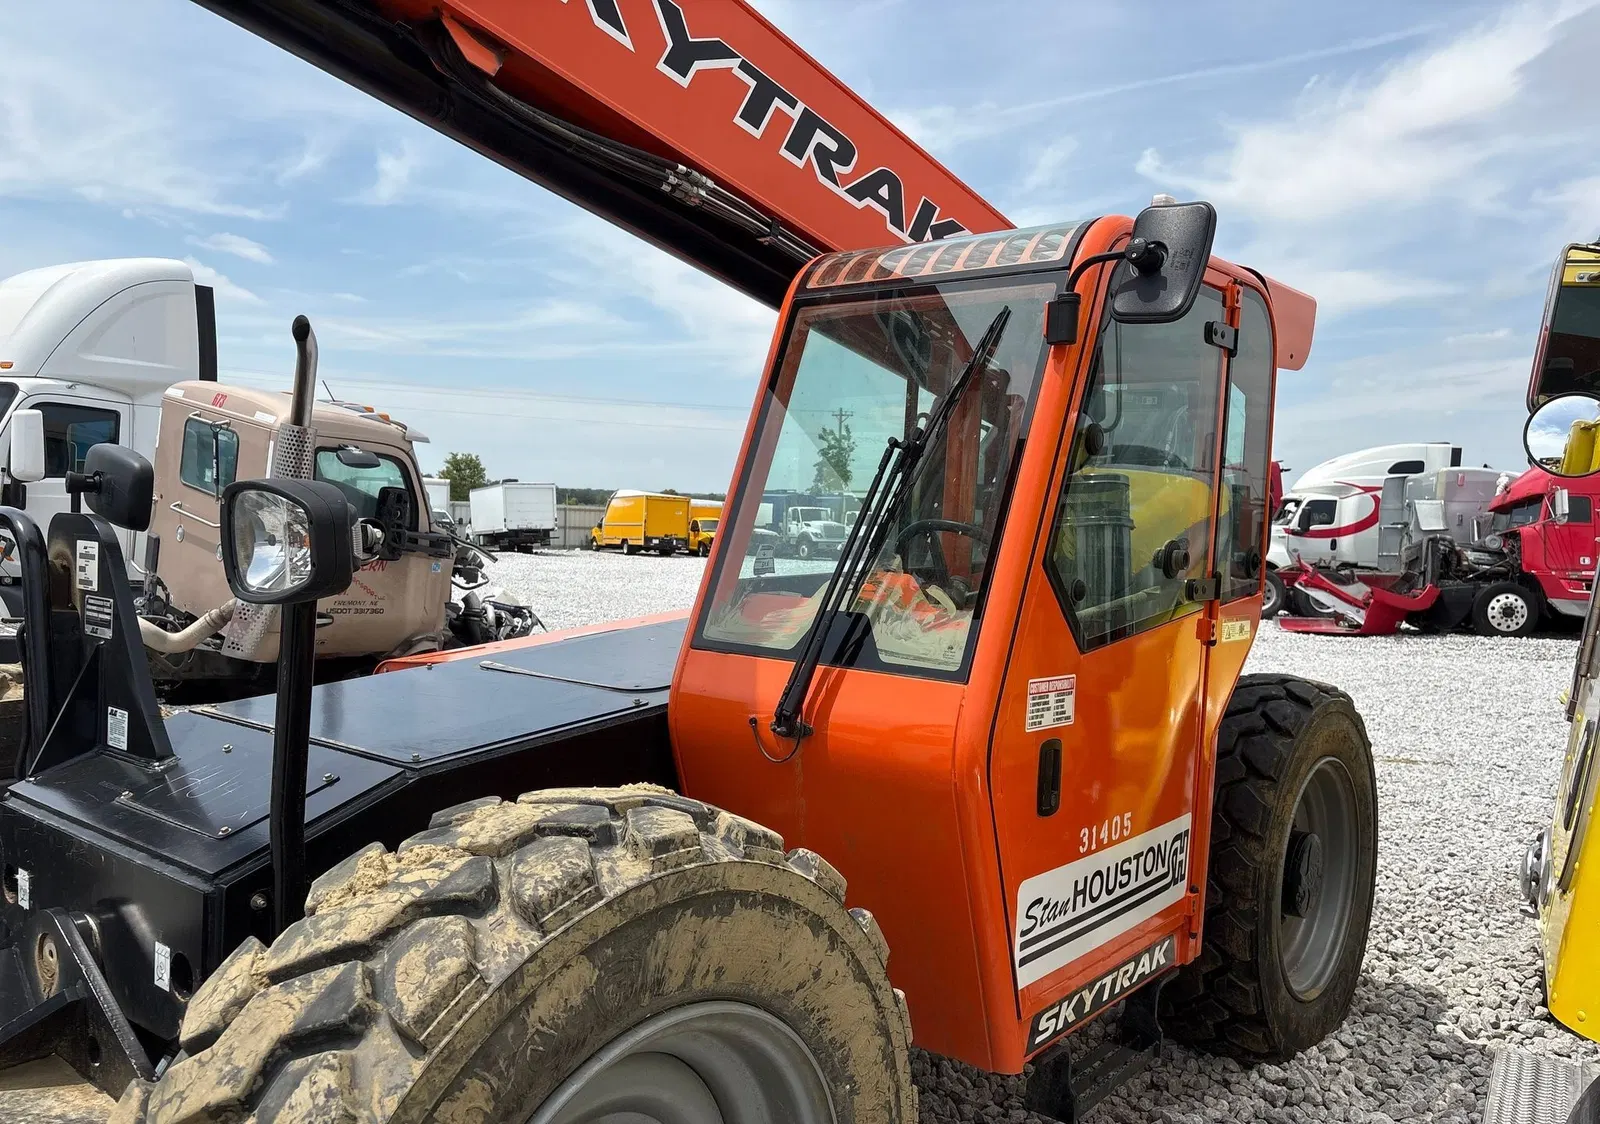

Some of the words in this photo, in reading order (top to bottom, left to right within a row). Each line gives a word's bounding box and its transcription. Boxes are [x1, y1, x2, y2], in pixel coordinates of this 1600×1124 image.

[559, 0, 973, 244] YTRAK
[211, 392, 228, 408] 673
[325, 607, 352, 615] USDOT
[1079, 812, 1132, 854] 31405
[1020, 896, 1073, 938] Stan
[1071, 840, 1169, 913] HOUSTON
[1034, 939, 1171, 1046] SKYTRAK
